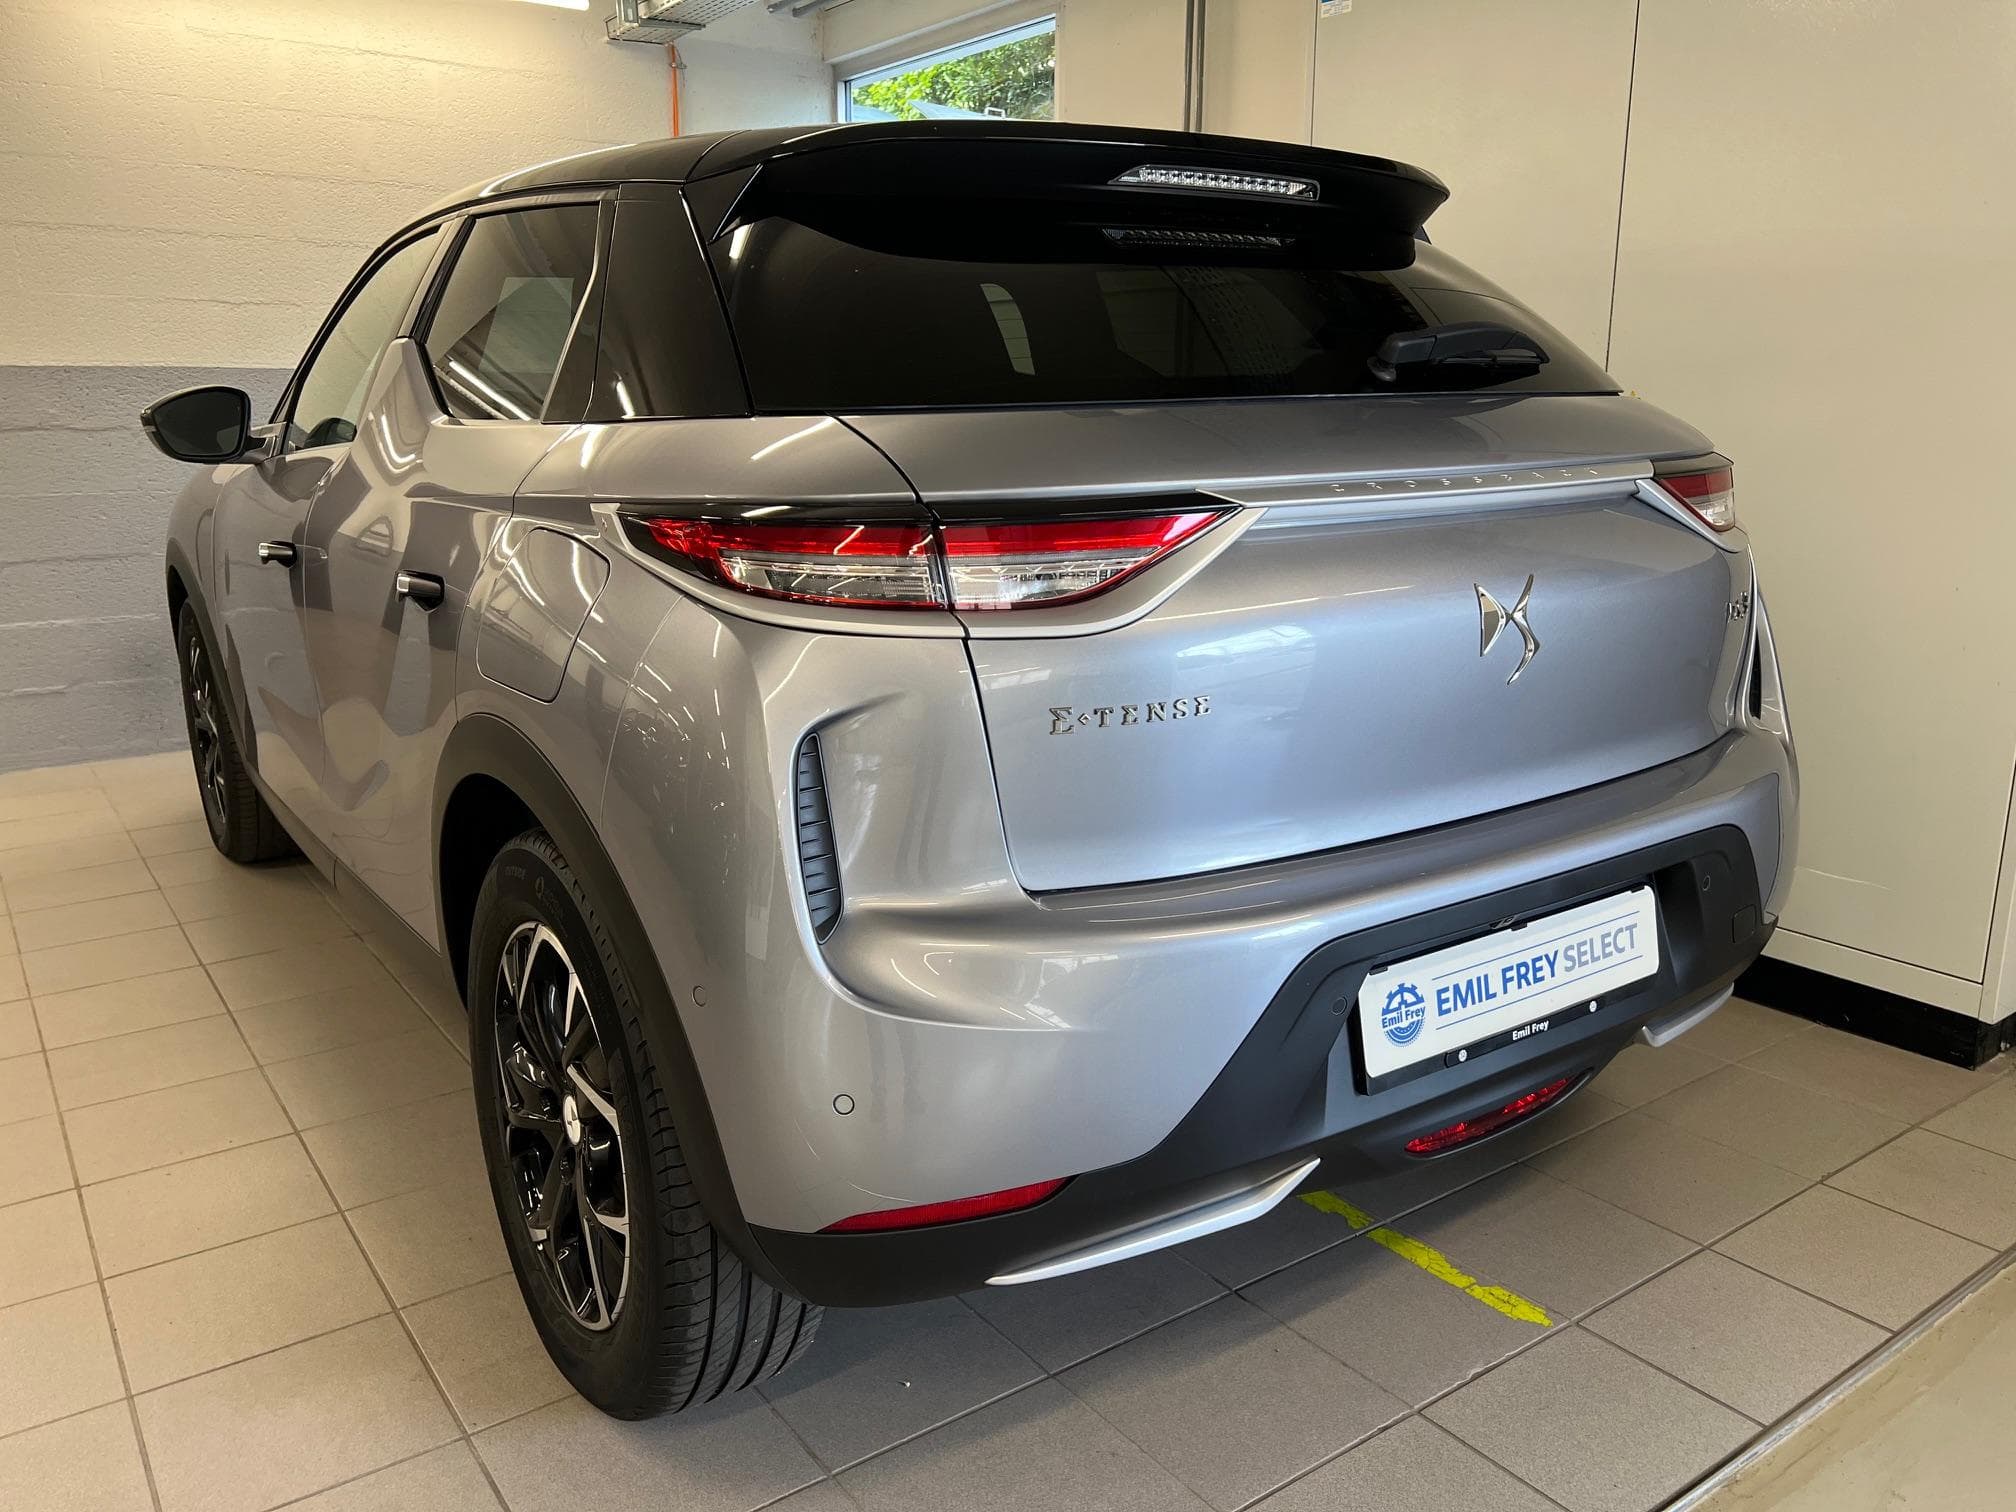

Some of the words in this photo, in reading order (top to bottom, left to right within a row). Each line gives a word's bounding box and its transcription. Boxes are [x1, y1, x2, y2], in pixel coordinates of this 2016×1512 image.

[1435, 972, 1497, 1017] EMIL
[1501, 949, 1560, 995] FREY
[1563, 922, 1638, 973] SELECT
[1381, 1009, 1405, 1029] Emil
[1404, 1006, 1426, 1022] Frey
[1512, 1025, 1531, 1041] Emil
[1531, 1020, 1549, 1035] Frey
